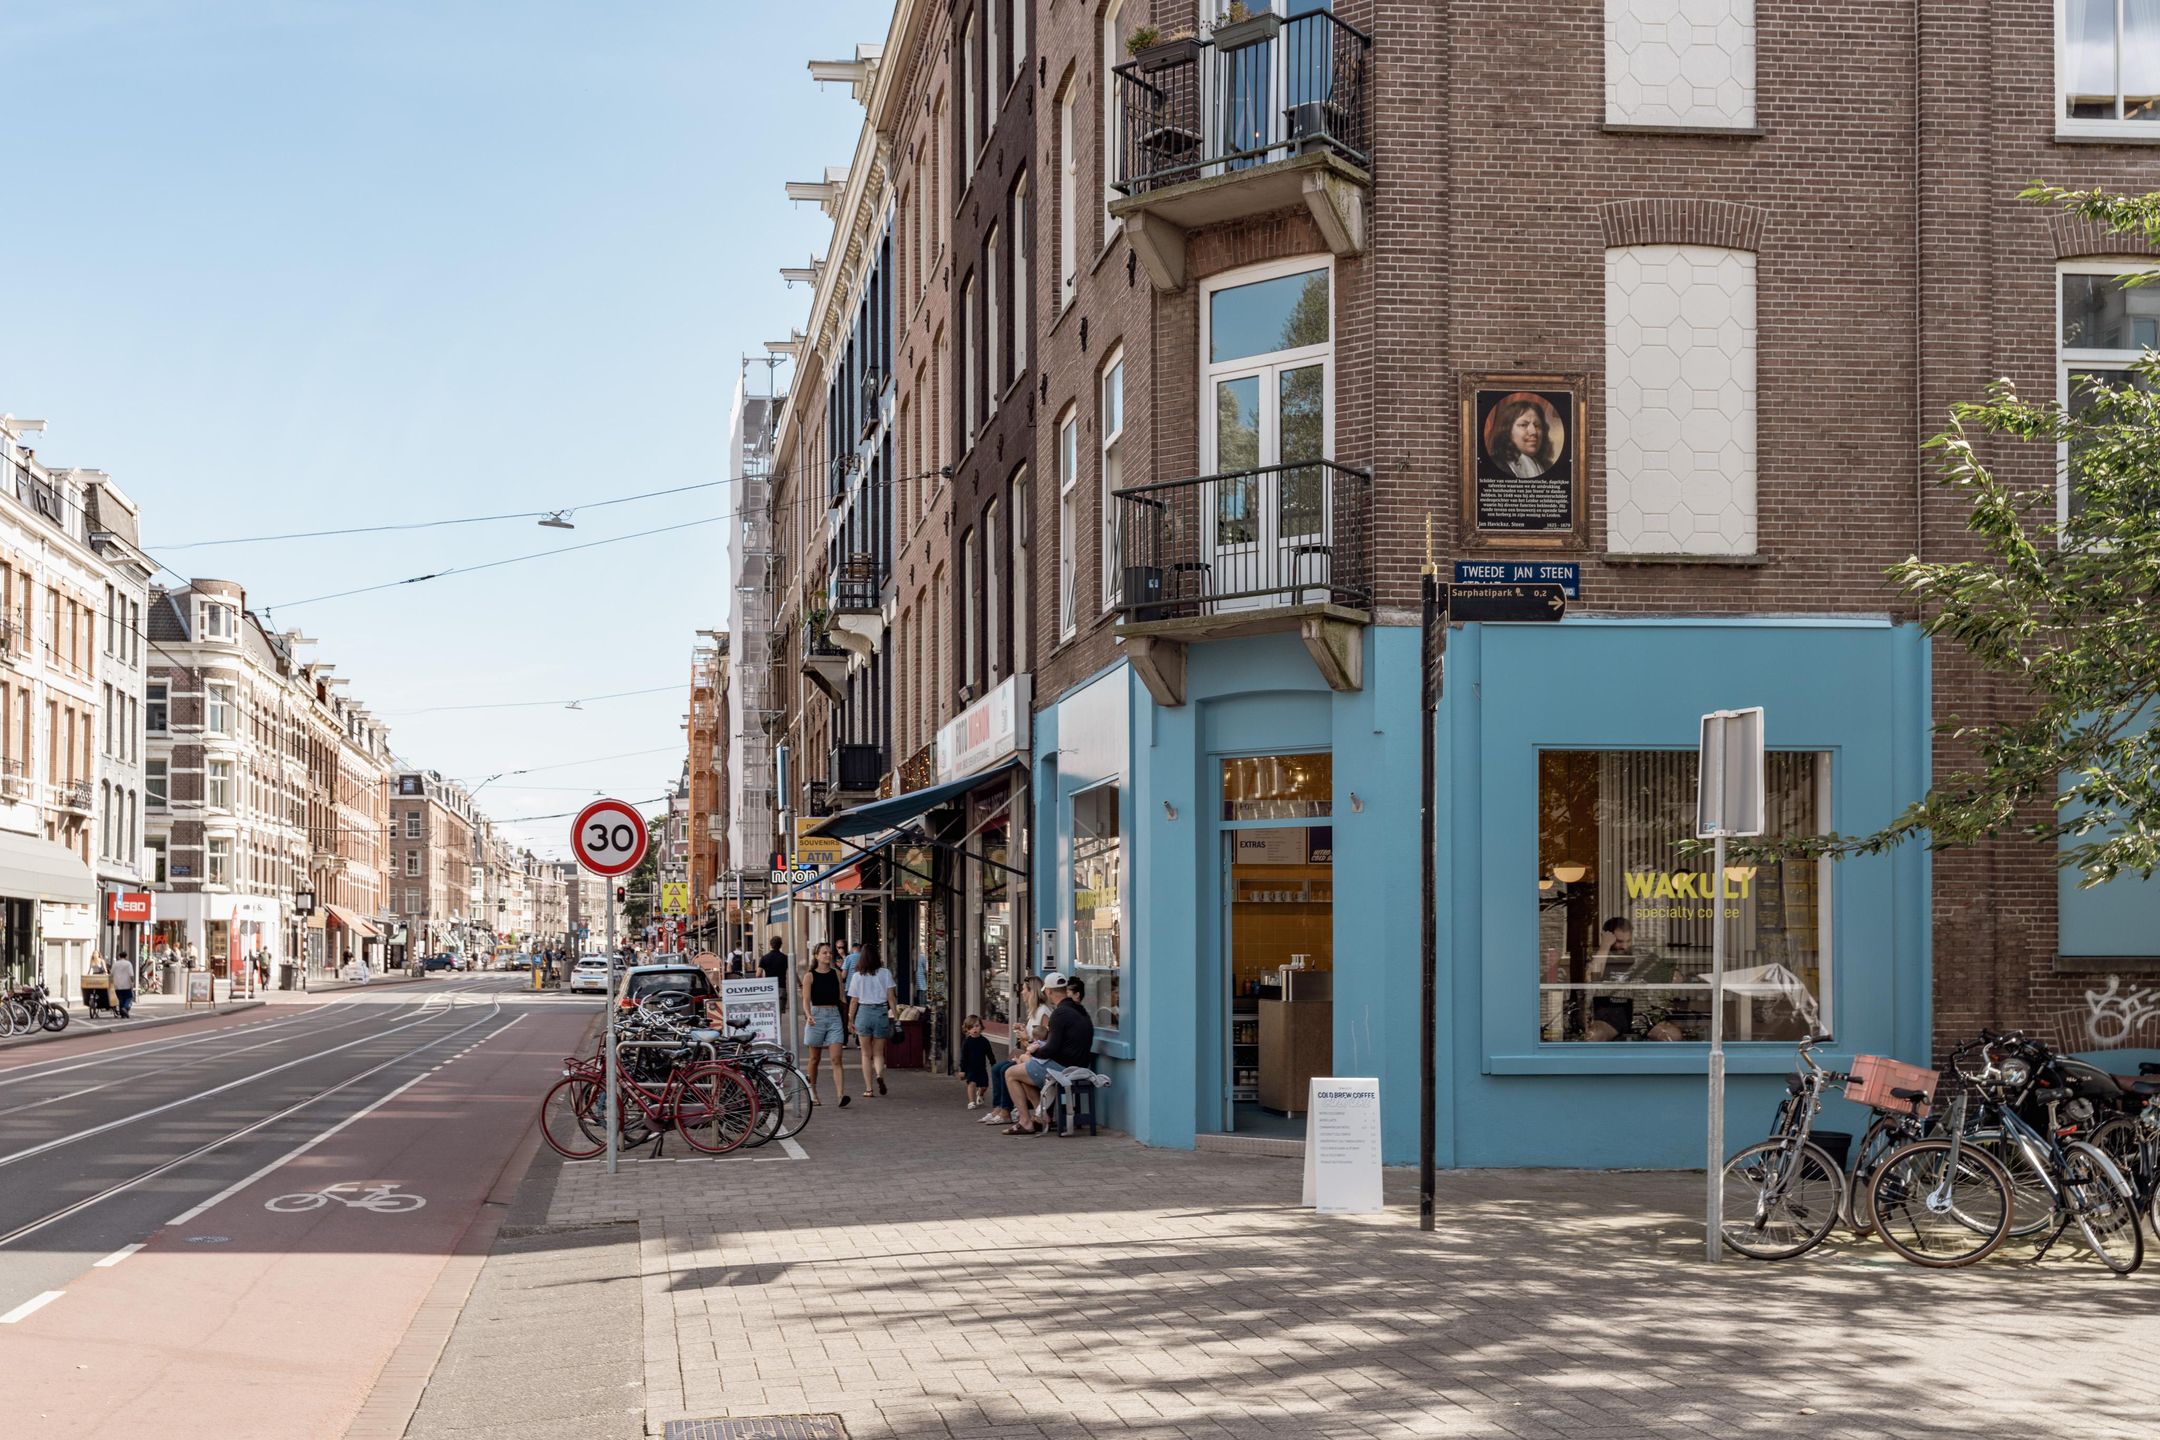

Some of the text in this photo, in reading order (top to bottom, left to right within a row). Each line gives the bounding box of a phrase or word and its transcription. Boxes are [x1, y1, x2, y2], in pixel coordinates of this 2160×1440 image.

[1462, 566, 1573, 580] TWEEDE JAN STEEN
[1452, 589, 1512, 598] Sarphatipark
[587, 824, 634, 851] 30
[807, 852, 833, 861] ATM
[1624, 872, 1750, 899] WAKULI
[114, 901, 145, 912] EBO
[1635, 906, 1740, 920] specialty coee
[726, 985, 774, 994] OLYMPUS
